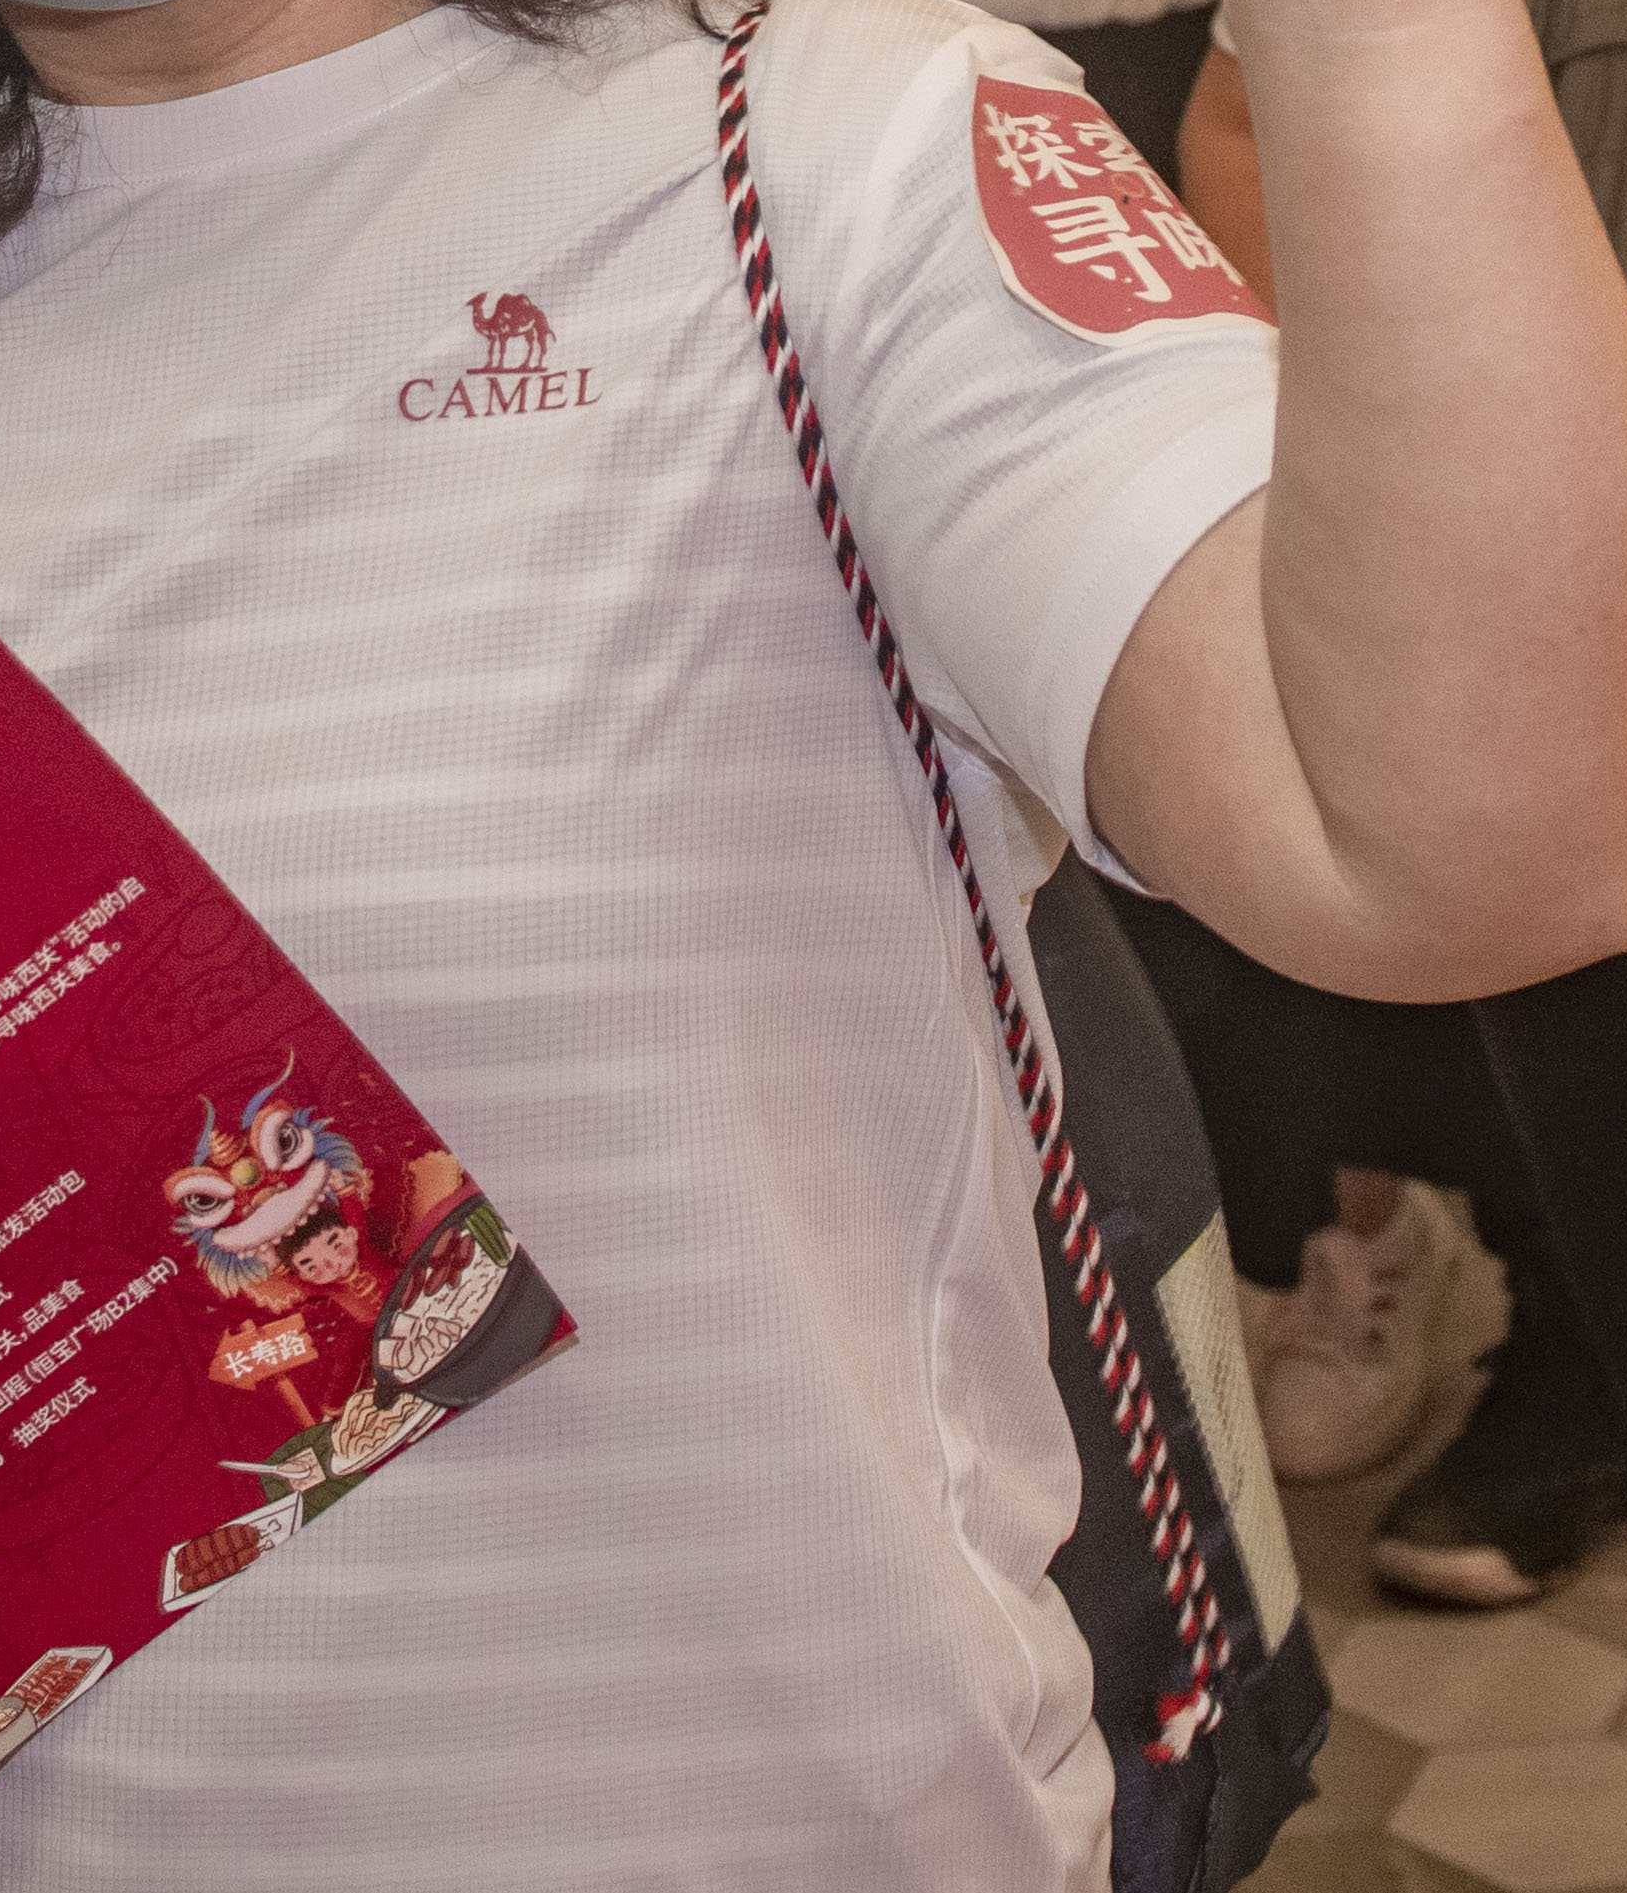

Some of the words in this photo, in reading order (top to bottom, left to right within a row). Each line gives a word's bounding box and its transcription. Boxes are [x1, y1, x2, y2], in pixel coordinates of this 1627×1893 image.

[399, 367, 603, 422] CAMEL
[224, 1329, 307, 1379] 长寿路
[11, 1375, 99, 1450] 抽奖仪式
